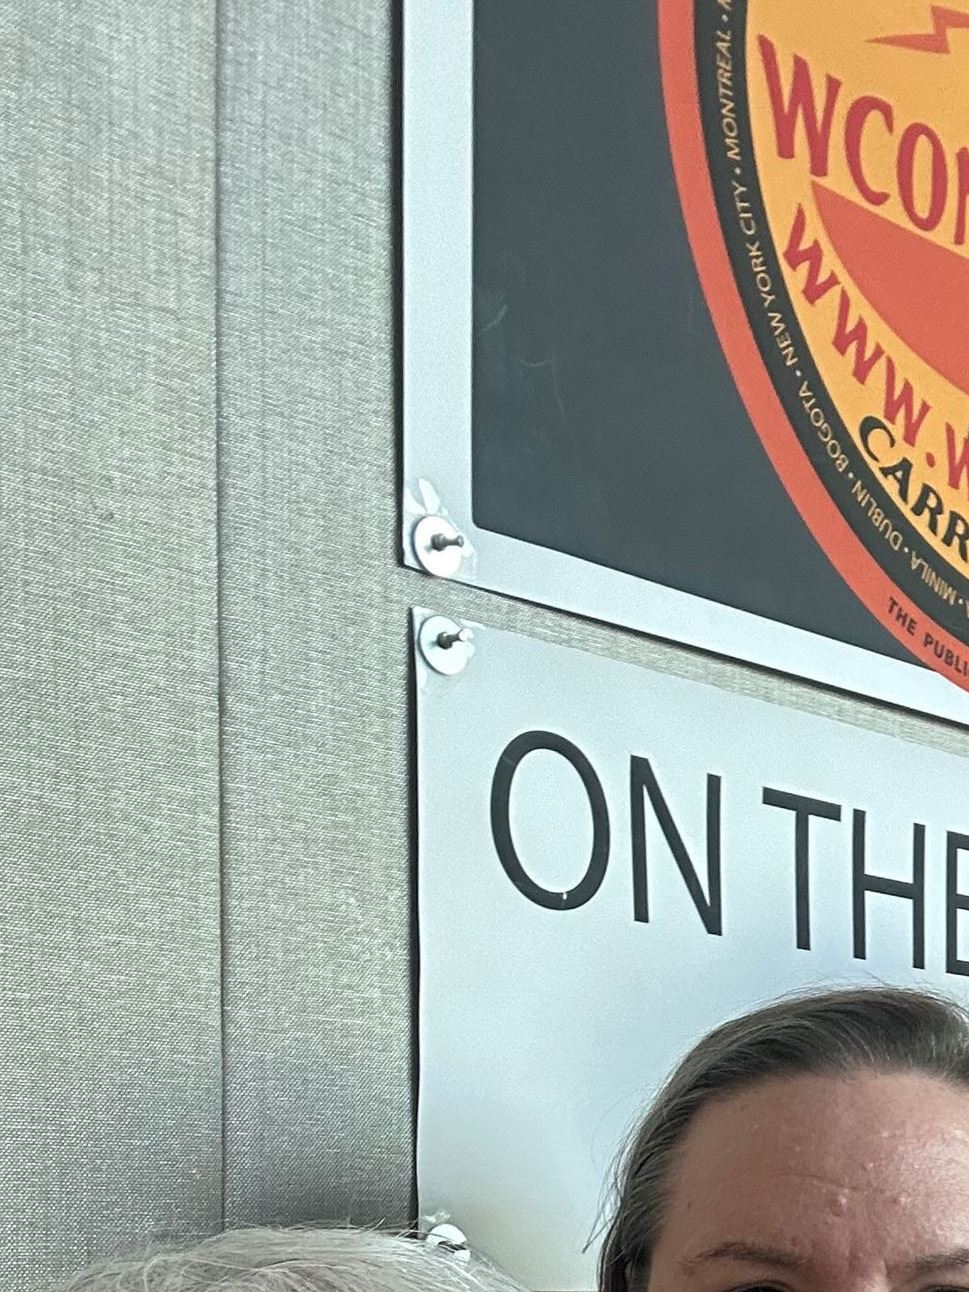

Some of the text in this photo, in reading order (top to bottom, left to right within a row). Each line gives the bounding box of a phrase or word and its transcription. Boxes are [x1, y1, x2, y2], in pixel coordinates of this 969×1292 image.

[713, 29, 741, 161] MONTREAL
[732, 182, 757, 236] CITY
[746, 241, 776, 308] YORK
[767, 311, 798, 367] NEW
[798, 380, 850, 473] BOGOTA
[851, 479, 904, 552] DUBLIN
[909, 550, 958, 606] MINILA
[886, 596, 918, 637] THE
[489, 730, 723, 937] ON
